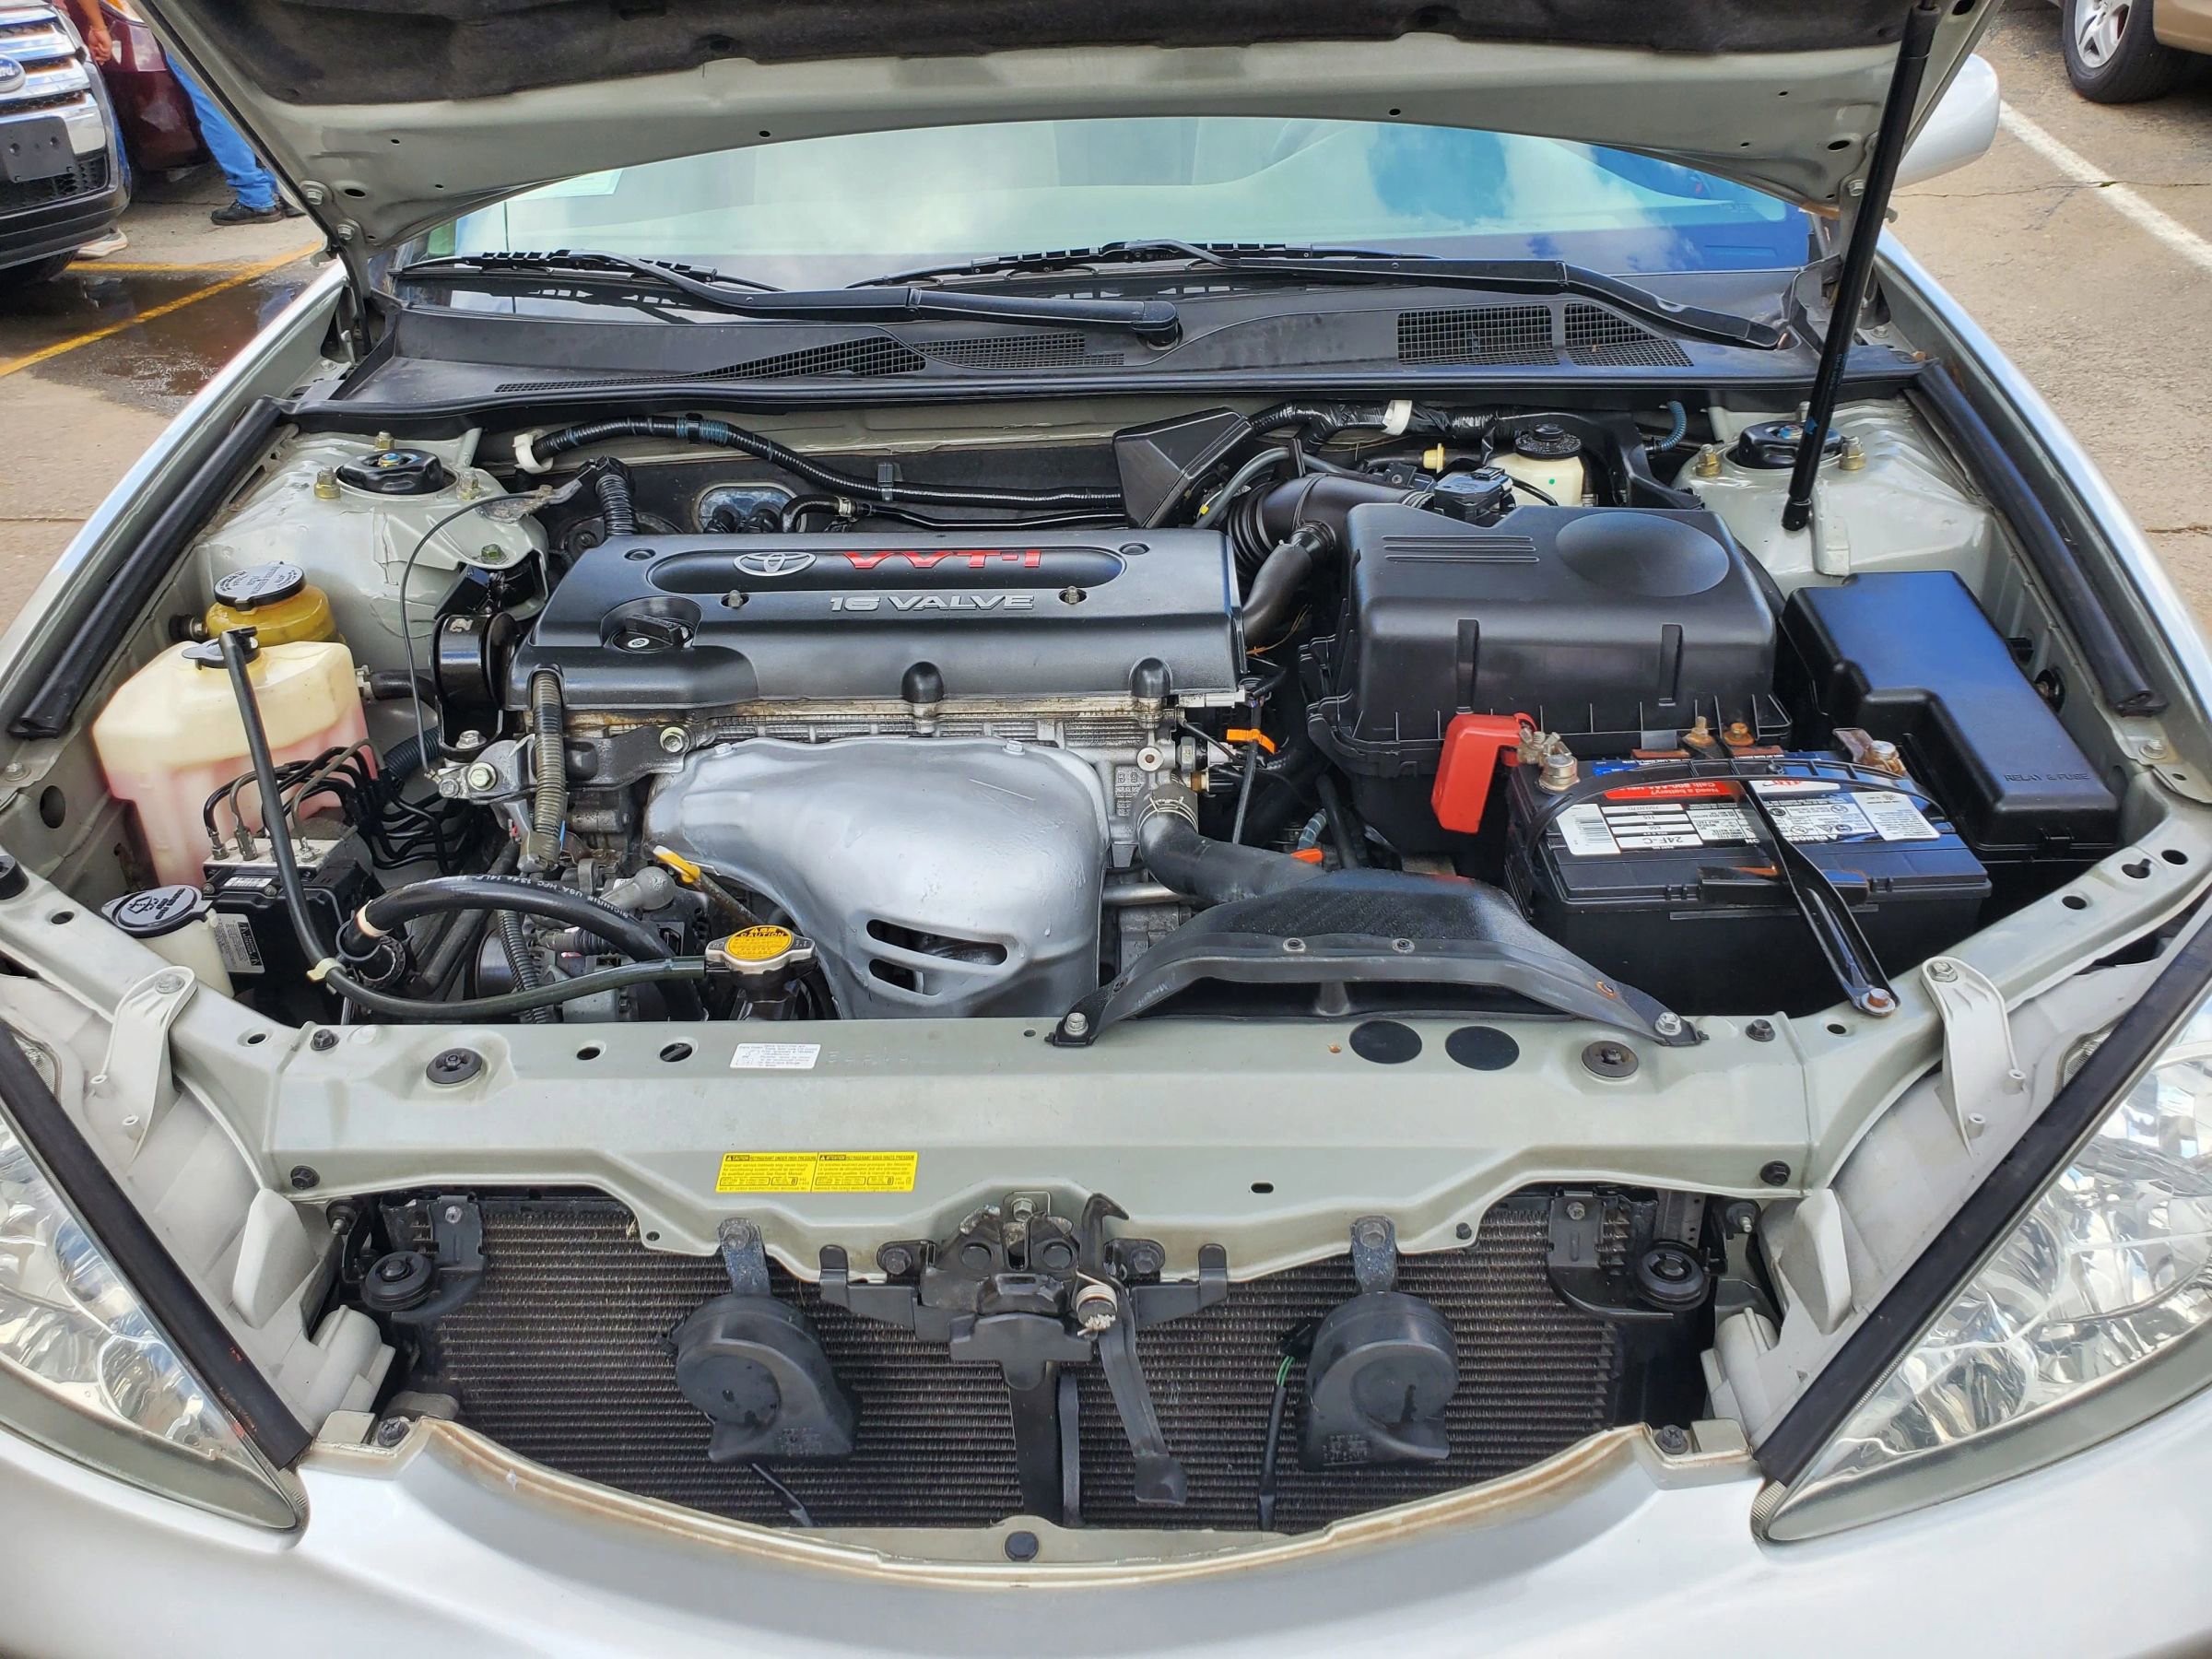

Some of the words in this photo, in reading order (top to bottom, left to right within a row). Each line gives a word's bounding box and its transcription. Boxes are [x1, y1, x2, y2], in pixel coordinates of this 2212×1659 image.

[830, 596, 880, 611] 16
[888, 594, 1034, 611] VALVE
[1642, 836, 1683, 844] 24F-C
[537, 881, 558, 890] HFC
[562, 886, 583, 898] USA
